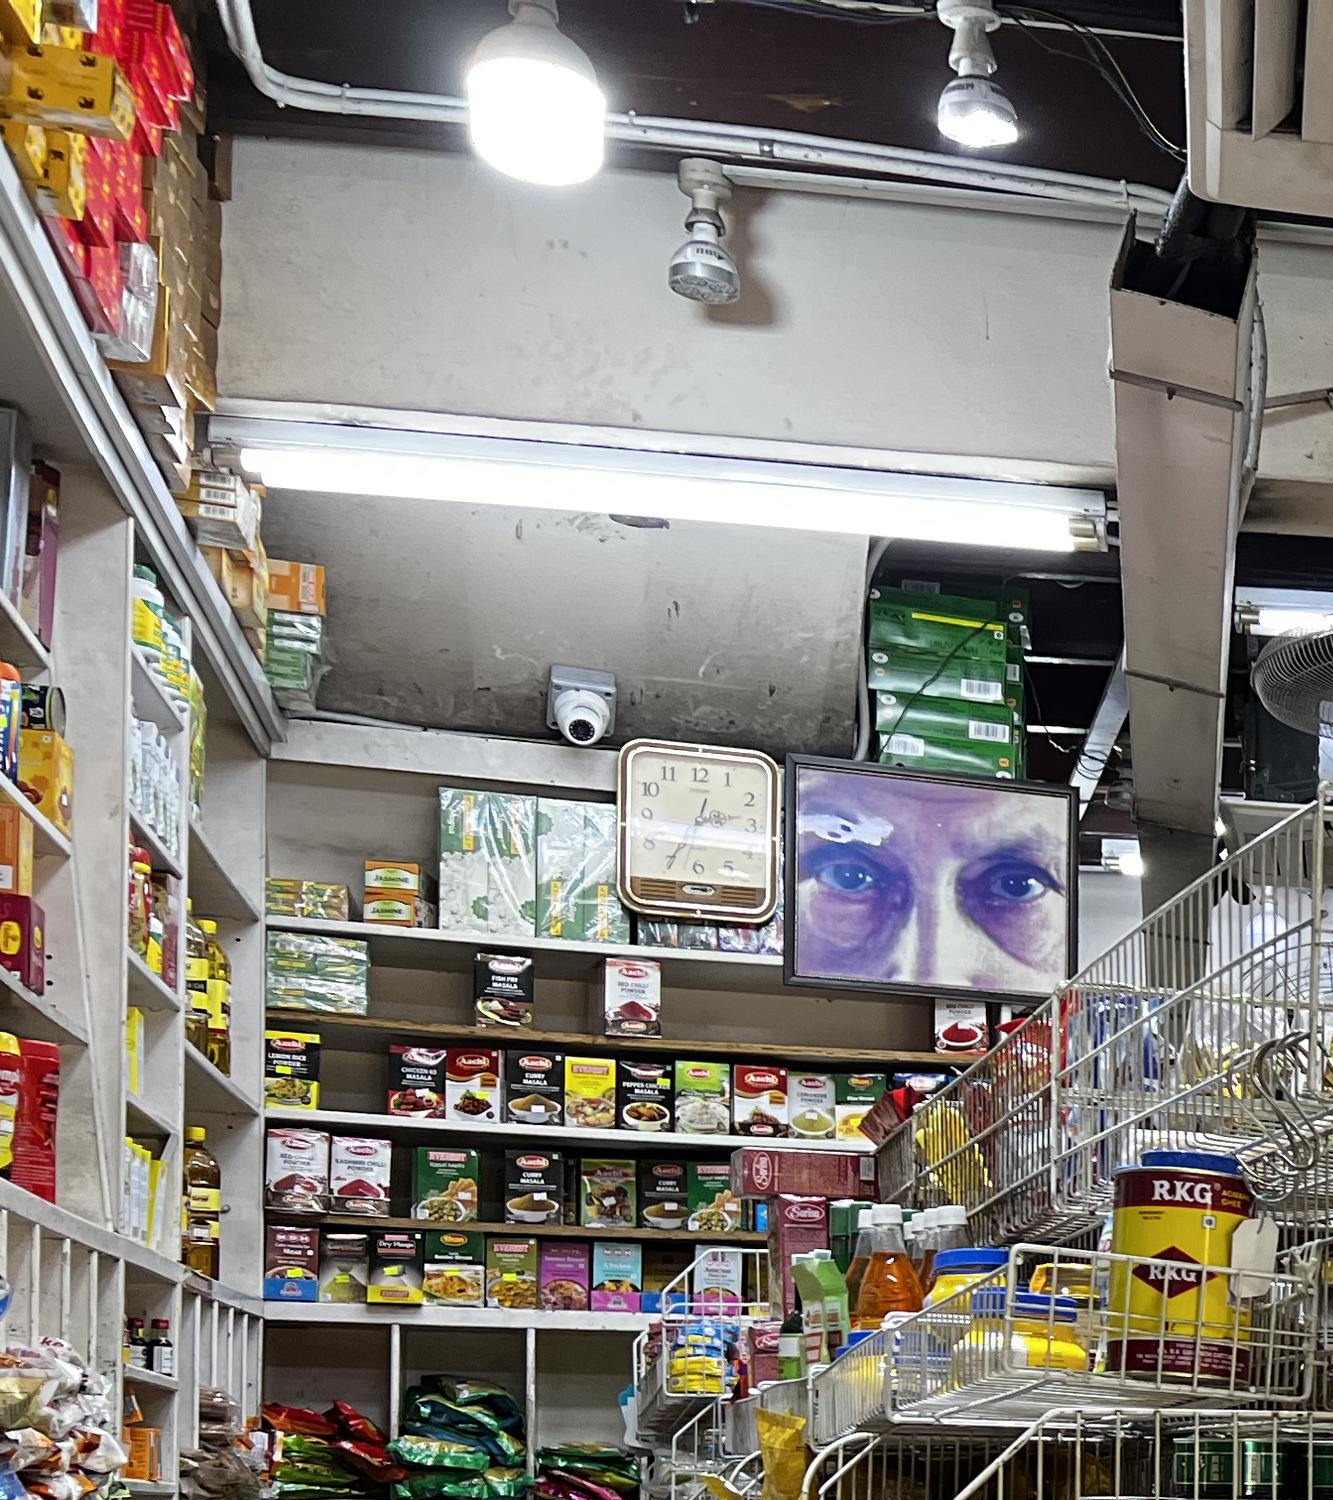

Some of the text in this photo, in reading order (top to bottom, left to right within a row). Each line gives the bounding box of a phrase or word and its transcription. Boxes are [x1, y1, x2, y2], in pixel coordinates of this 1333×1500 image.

[661, 766, 677, 782] 11
[691, 767, 710, 783] 12
[724, 772, 732, 787] 1
[641, 782, 660, 797] 10
[744, 792, 755, 807] 2
[745, 818, 757, 833] 3
[666, 855, 676, 870] 7
[692, 860, 705, 875] 6
[723, 860, 734, 876] 5
[374, 874, 410, 884] JASMINE
[370, 906, 403, 916] JASMINE
[619, 968, 646, 977] Aachi
[492, 981, 518, 990] MASALA
[274, 1038, 302, 1050] Aachi
[458, 1056, 489, 1067] Aachi
[521, 1057, 551, 1068] Aachi
[573, 1065, 609, 1075] EVEREST
[687, 1069, 711, 1078] Aachi
[523, 1078, 547, 1086] MASALA
[745, 1074, 778, 1086] Aachi
[800, 1078, 825, 1087] Aachi
[428, 1152, 467, 1162] EVEREST
[517, 1157, 548, 1168] Aachi
[653, 1165, 682, 1176] Aachi
[1151, 1179, 1213, 1204] RKG
[1221, 1198, 1242, 1208] GHEE
[1149, 1264, 1197, 1282] RKG
